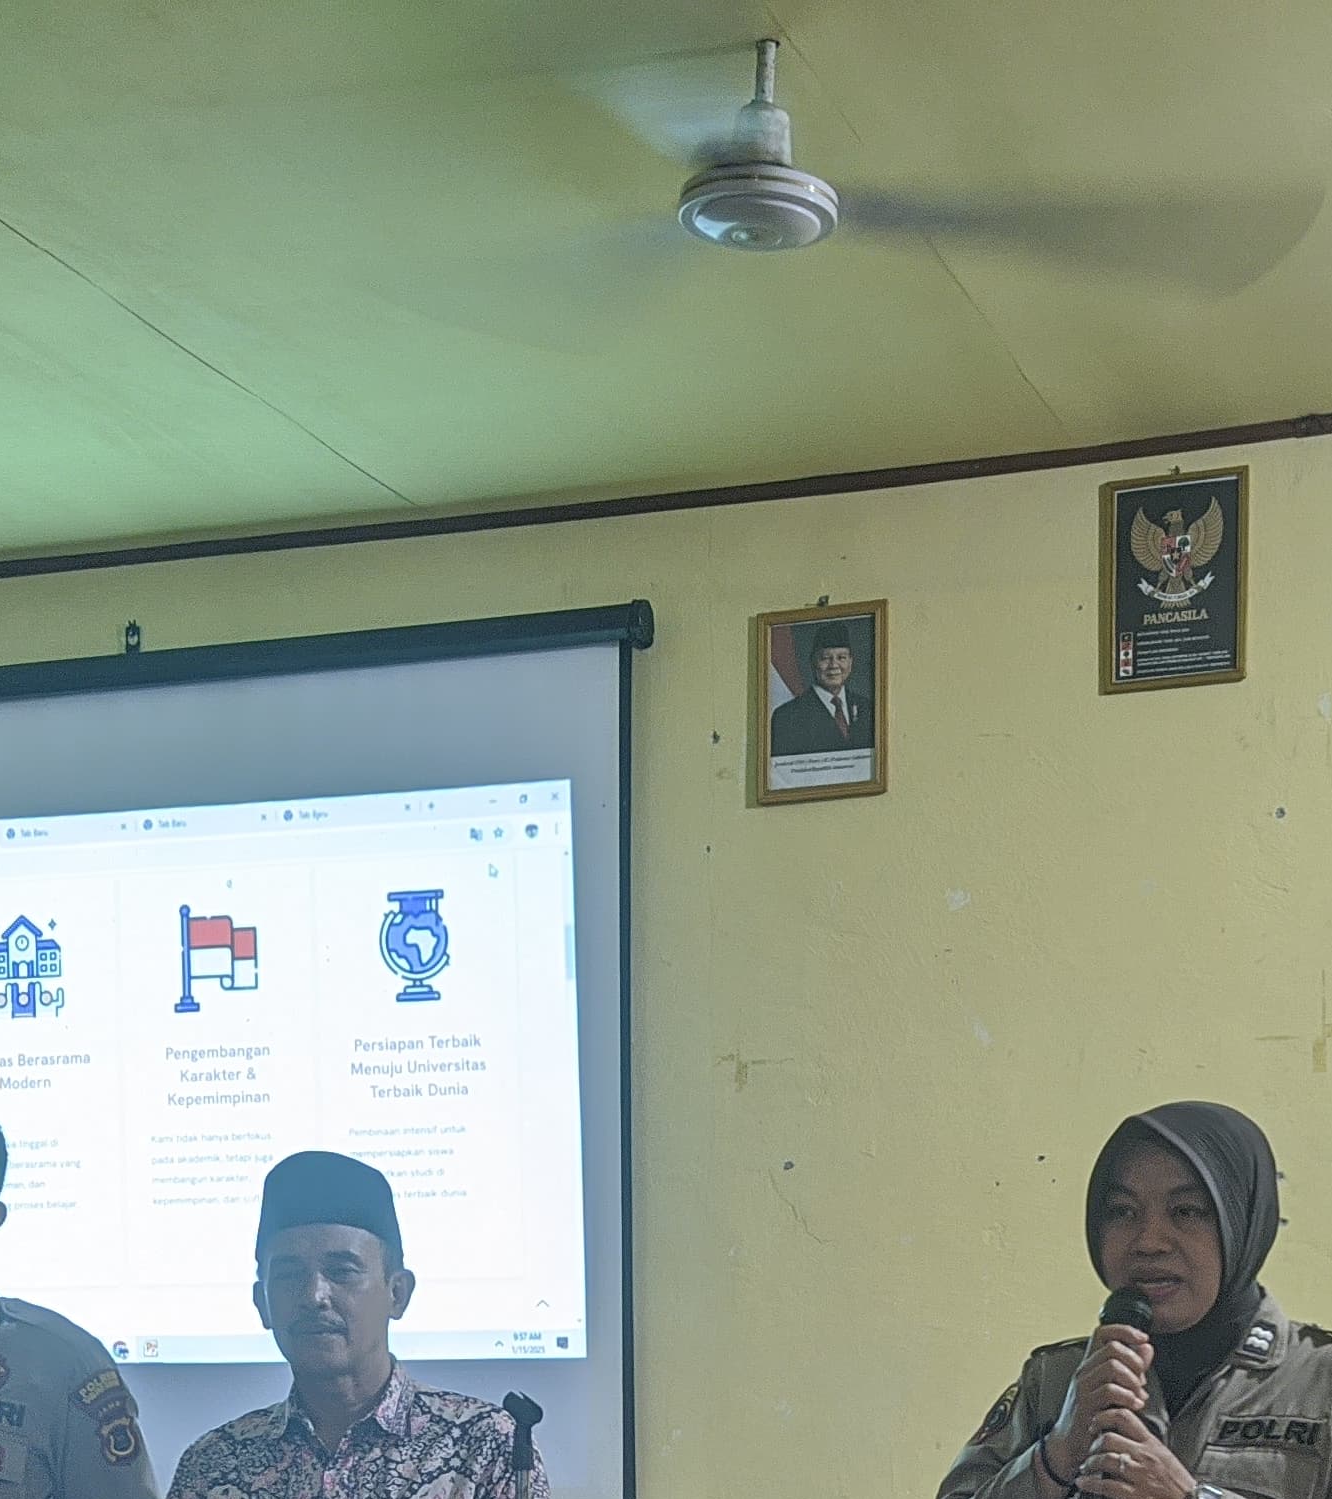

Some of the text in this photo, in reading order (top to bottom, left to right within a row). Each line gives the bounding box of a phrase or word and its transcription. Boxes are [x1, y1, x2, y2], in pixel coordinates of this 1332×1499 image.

[1142, 608, 1208, 625] PANCASILA
[354, 1035, 481, 1053] Persiapan Terbaik
[17, 1053, 91, 1067] Berasrama
[165, 1045, 270, 1062] Pengembangan
[180, 1068, 256, 1082] Karakter &
[351, 1059, 486, 1077] Menuju Universitas
[0, 1076, 51, 1090] Modern
[370, 1083, 468, 1099] Terbaik Dunia
[167, 1090, 270, 1108] Kepemimpinan
[1218, 1419, 1322, 1447] POLRI
